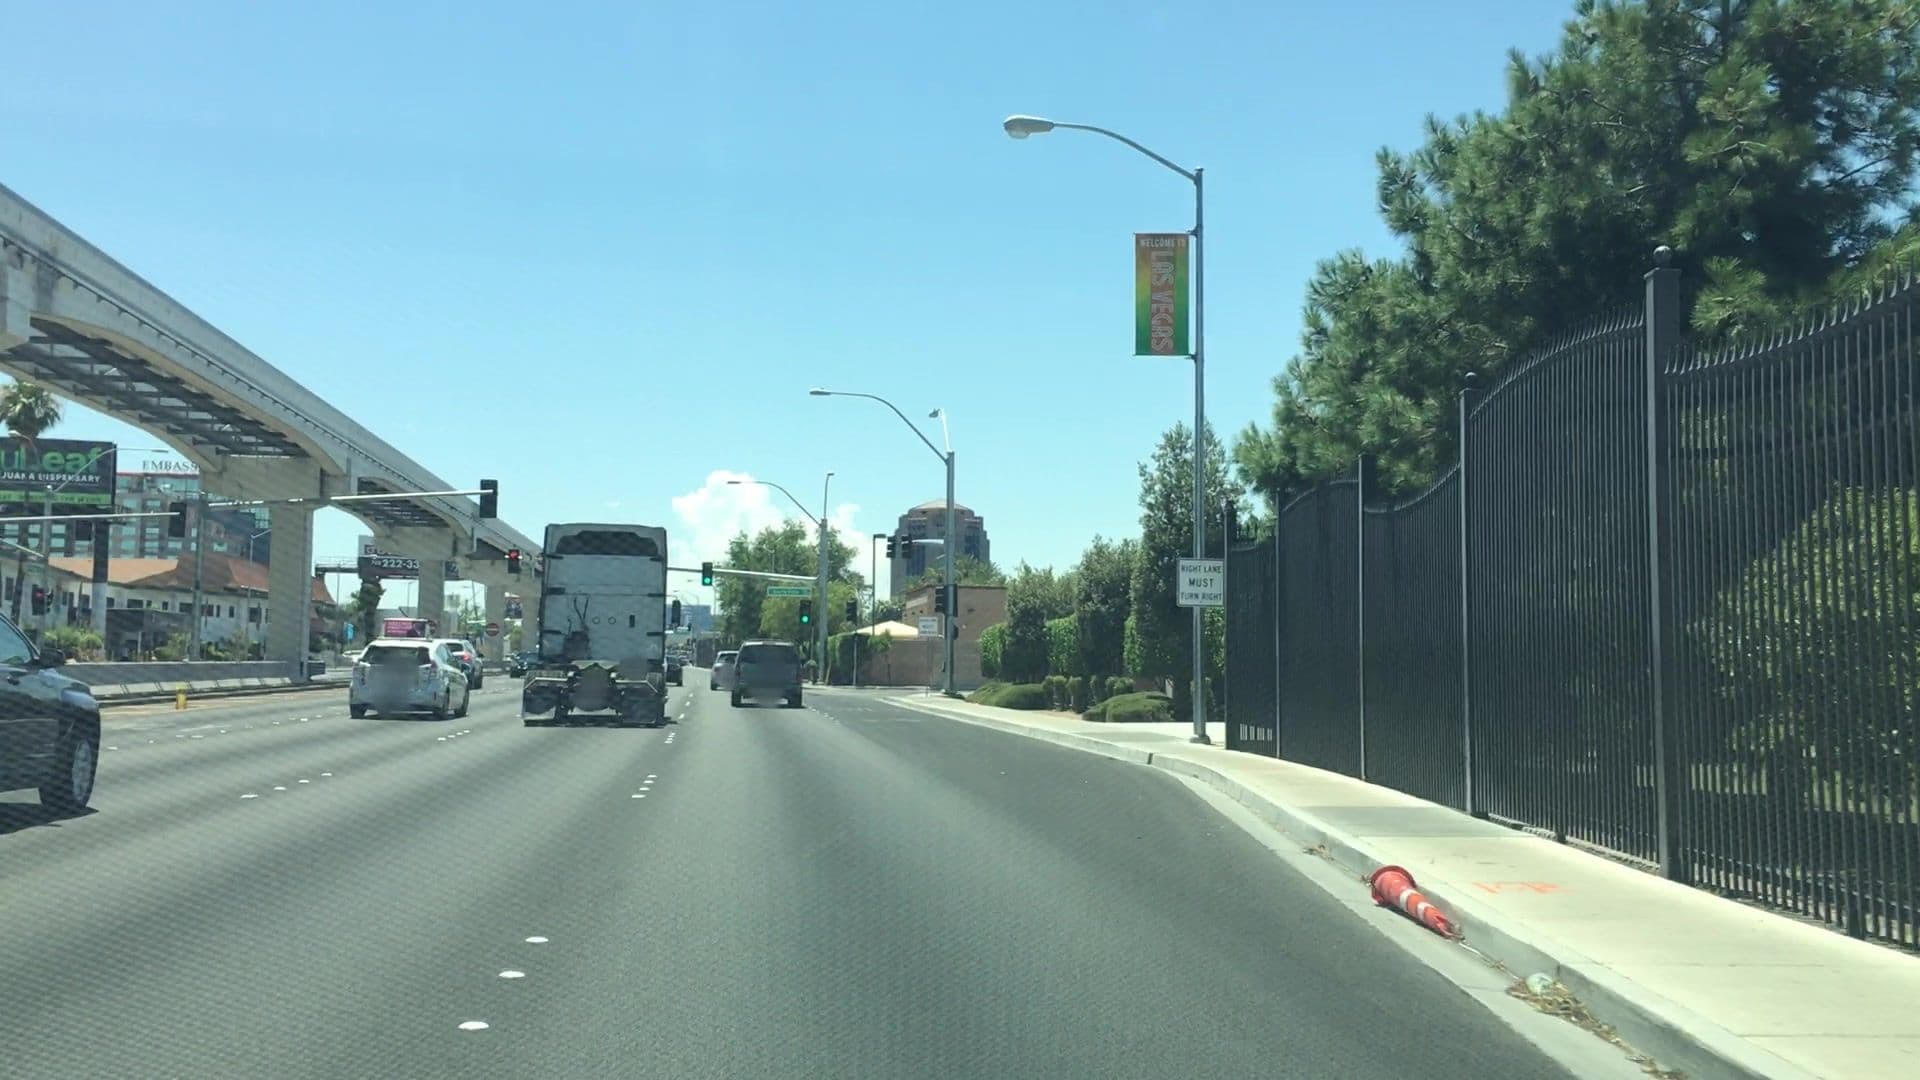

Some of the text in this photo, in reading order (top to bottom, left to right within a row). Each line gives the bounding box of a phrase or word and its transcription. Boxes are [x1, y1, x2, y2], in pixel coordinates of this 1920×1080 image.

[1139, 239, 1175, 248] WELCOME
[1151, 249, 1174, 351] LAS VEGAS
[1181, 565, 1221, 574] RIGHT LANE
[1188, 578, 1214, 588] MUST
[1181, 592, 1222, 601] TURN RIGHT
